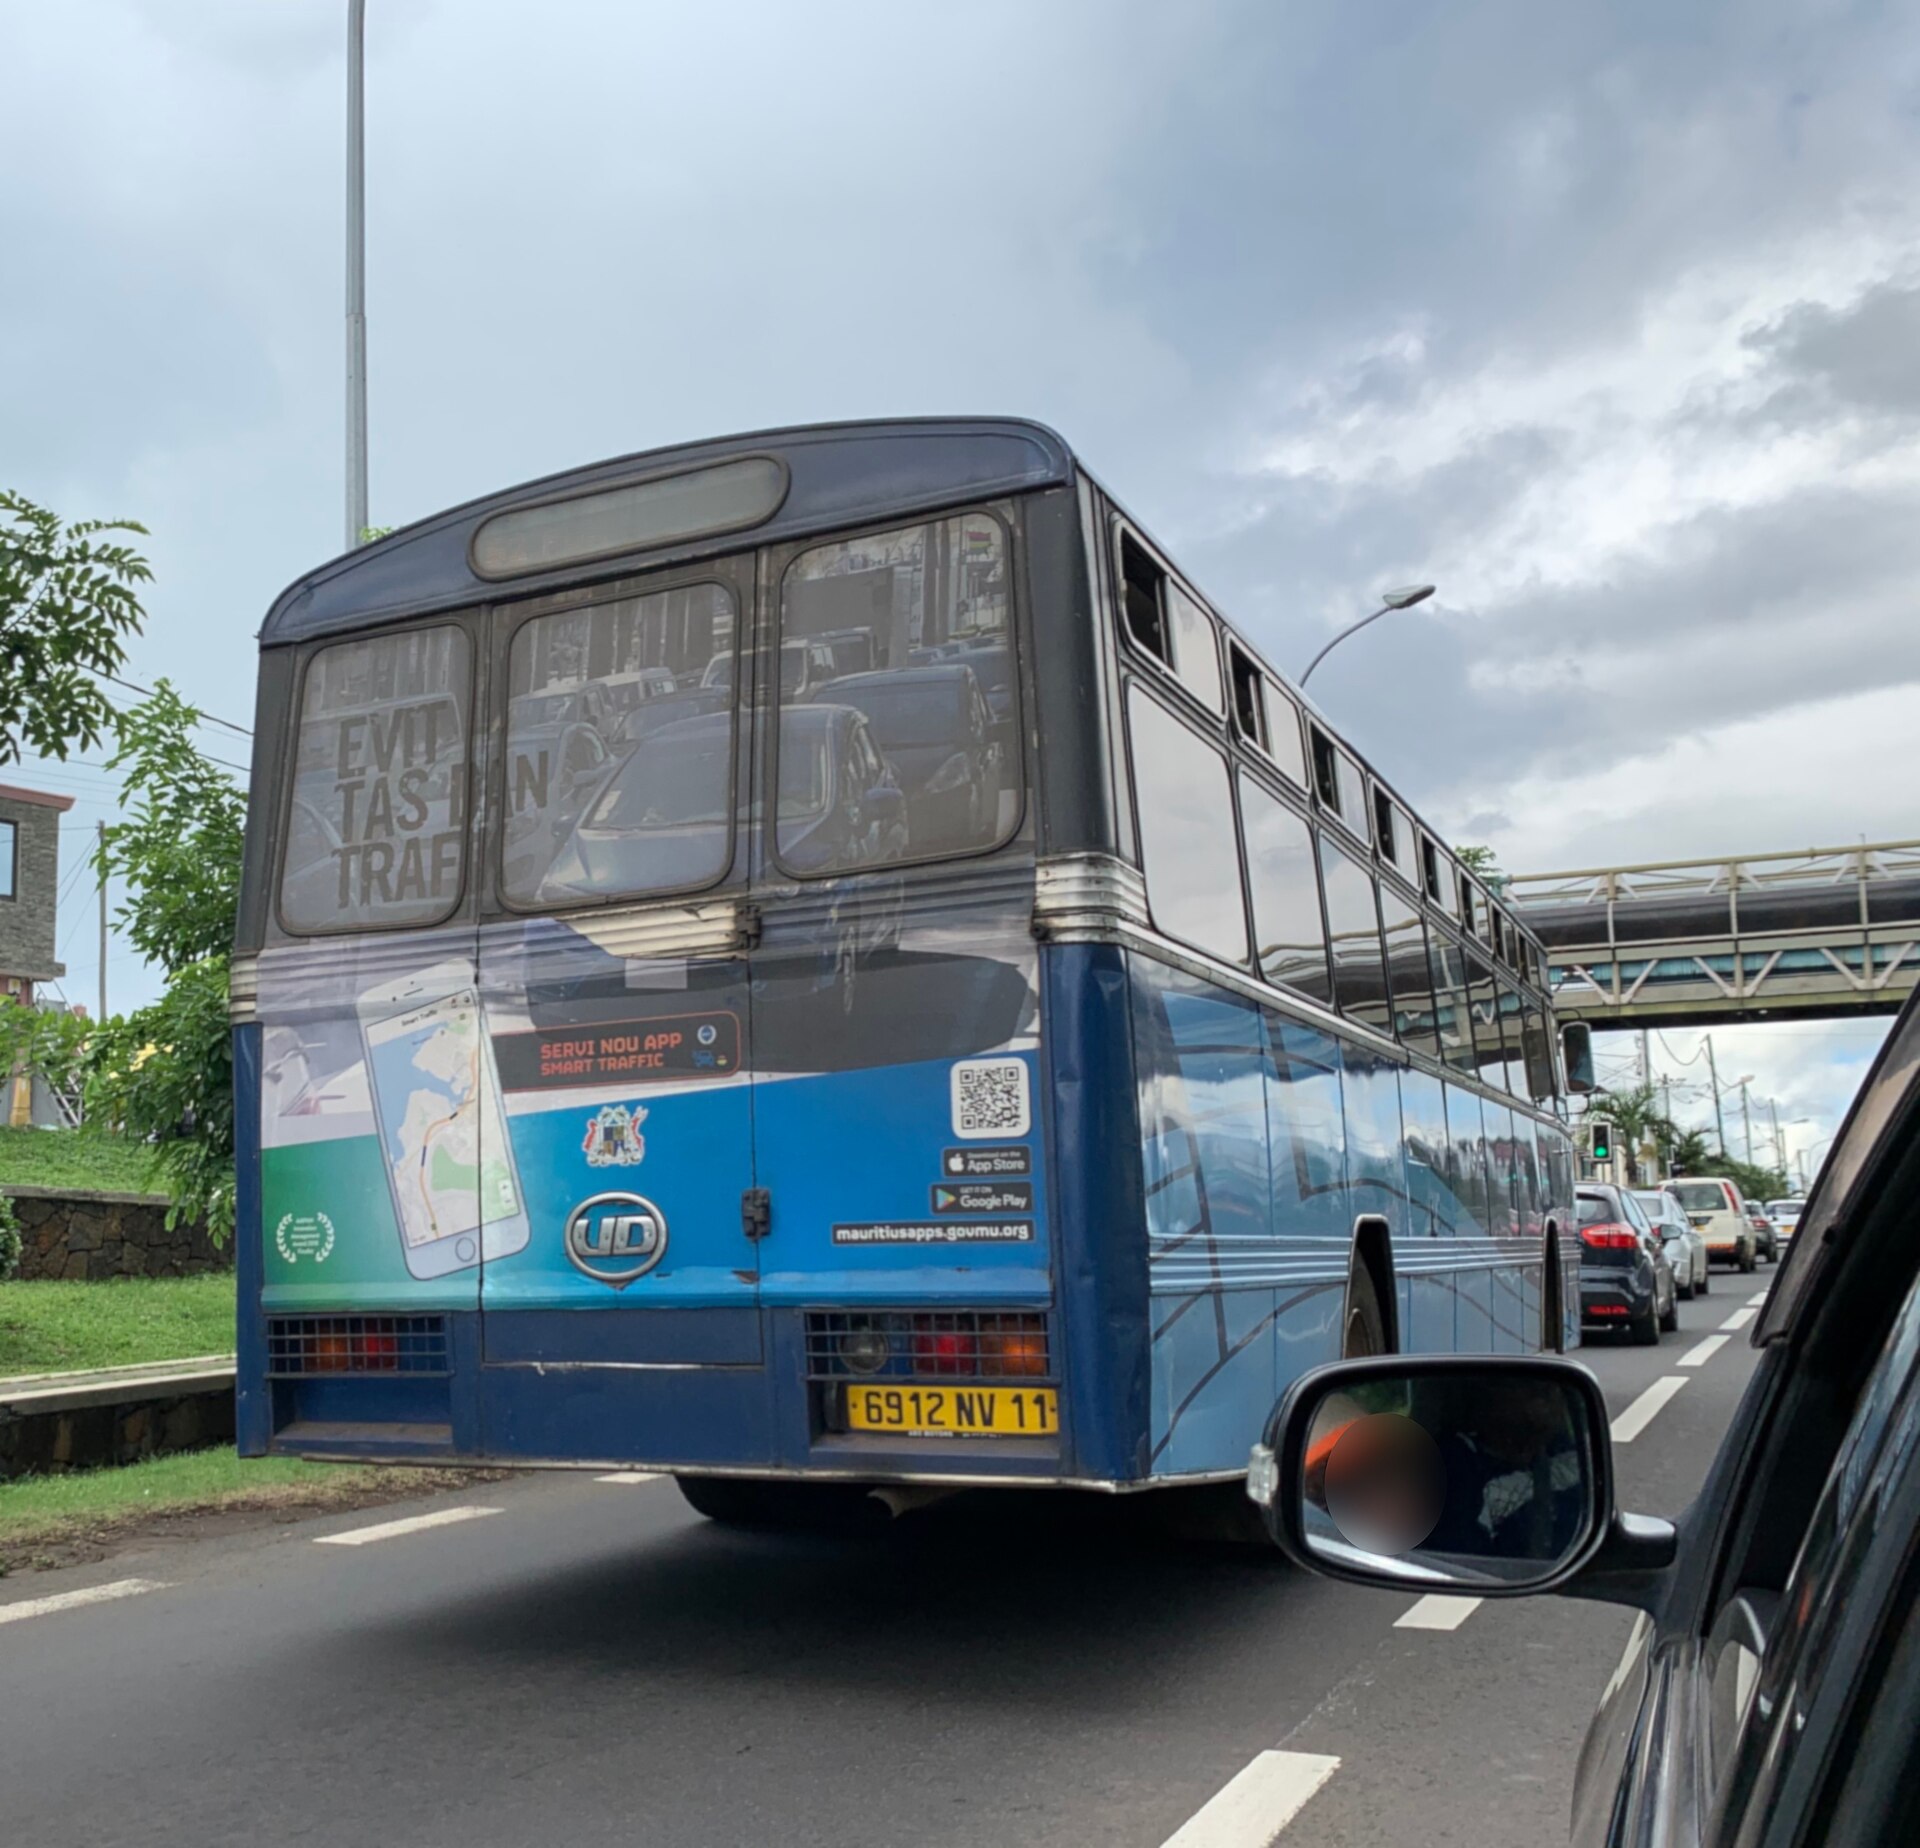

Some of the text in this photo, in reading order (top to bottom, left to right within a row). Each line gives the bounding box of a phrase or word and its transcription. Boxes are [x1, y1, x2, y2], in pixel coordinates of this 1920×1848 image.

[337, 701, 449, 780] EVIT
[334, 769, 430, 843] TAS
[541, 1032, 682, 1060] SERVI NOU APP
[541, 1053, 664, 1077] SMART TRAFFIC
[967, 1158, 1025, 1173] App Store
[960, 1193, 1027, 1210] Google Play
[571, 1214, 659, 1256] UD
[836, 1224, 1029, 1242] mauritiusapps.govmu.org
[865, 1391, 1047, 1429] 6912 NV 11
